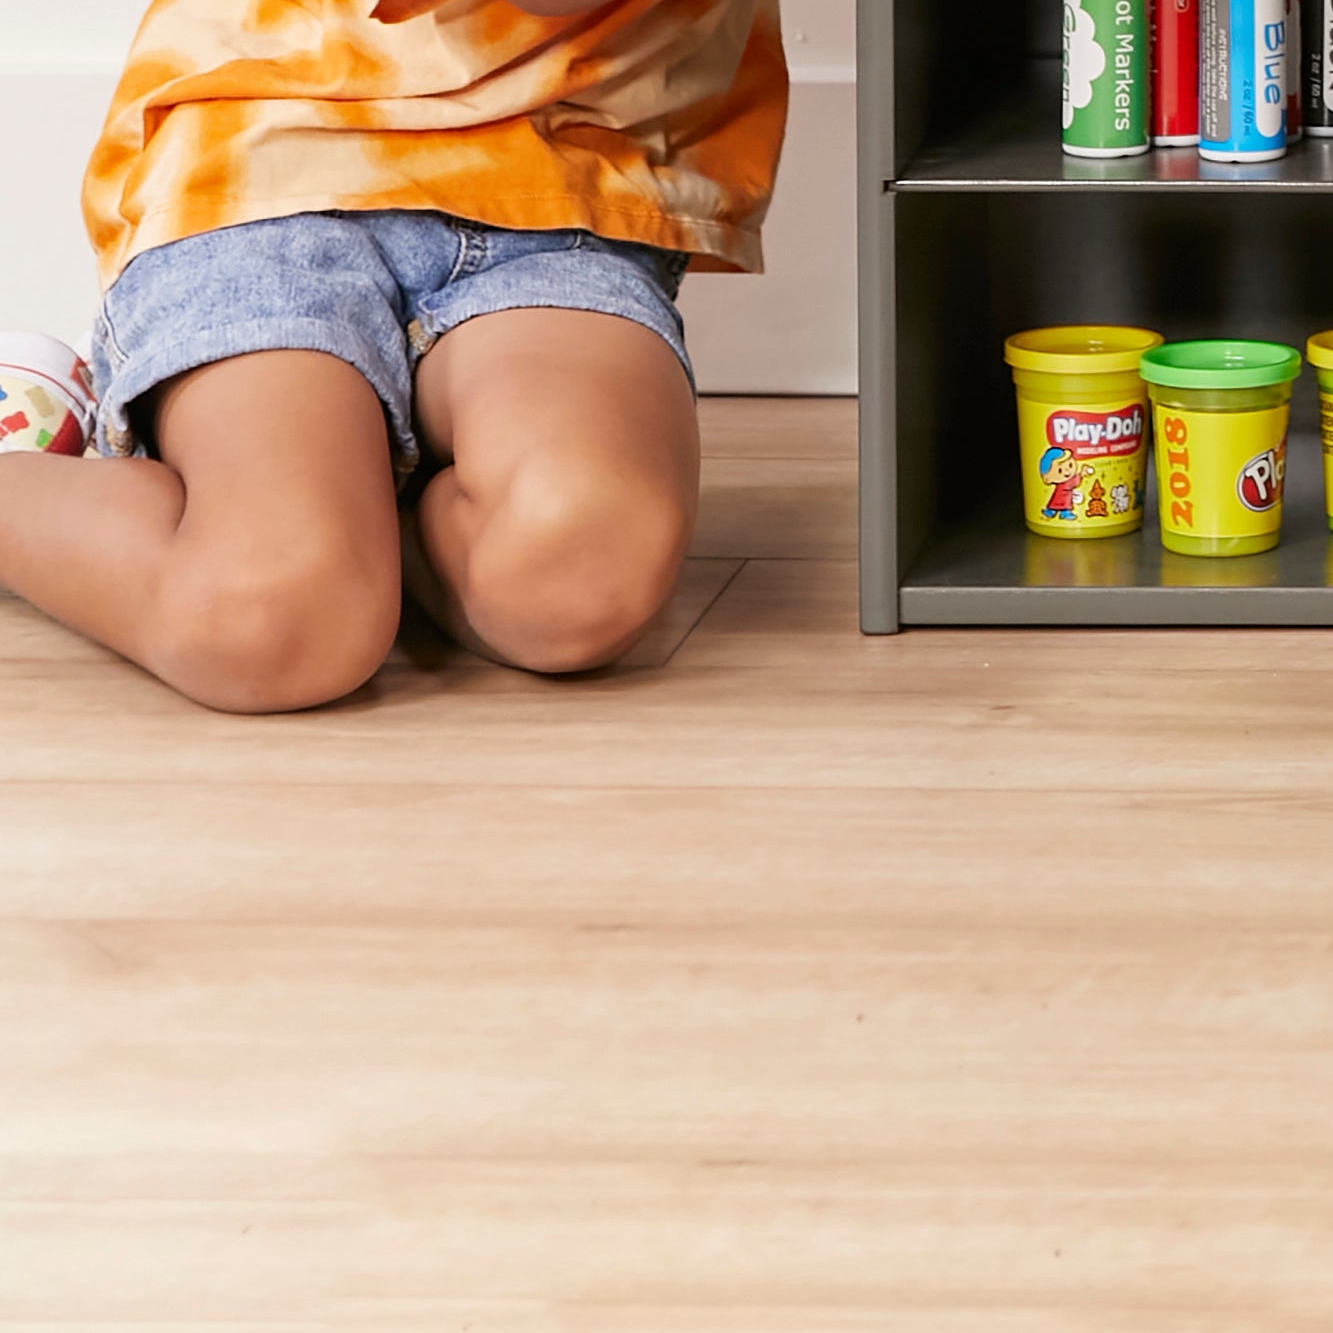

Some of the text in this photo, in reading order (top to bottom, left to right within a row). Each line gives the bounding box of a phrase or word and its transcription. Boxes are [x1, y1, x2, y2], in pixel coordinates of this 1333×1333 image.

[1113, 34, 1136, 131] Markers
[1264, 20, 1286, 106] Blue
[1242, 110, 1252, 124] 60
[1052, 409, 1142, 445] Play-Doh
[1164, 416, 1195, 528] 2018
